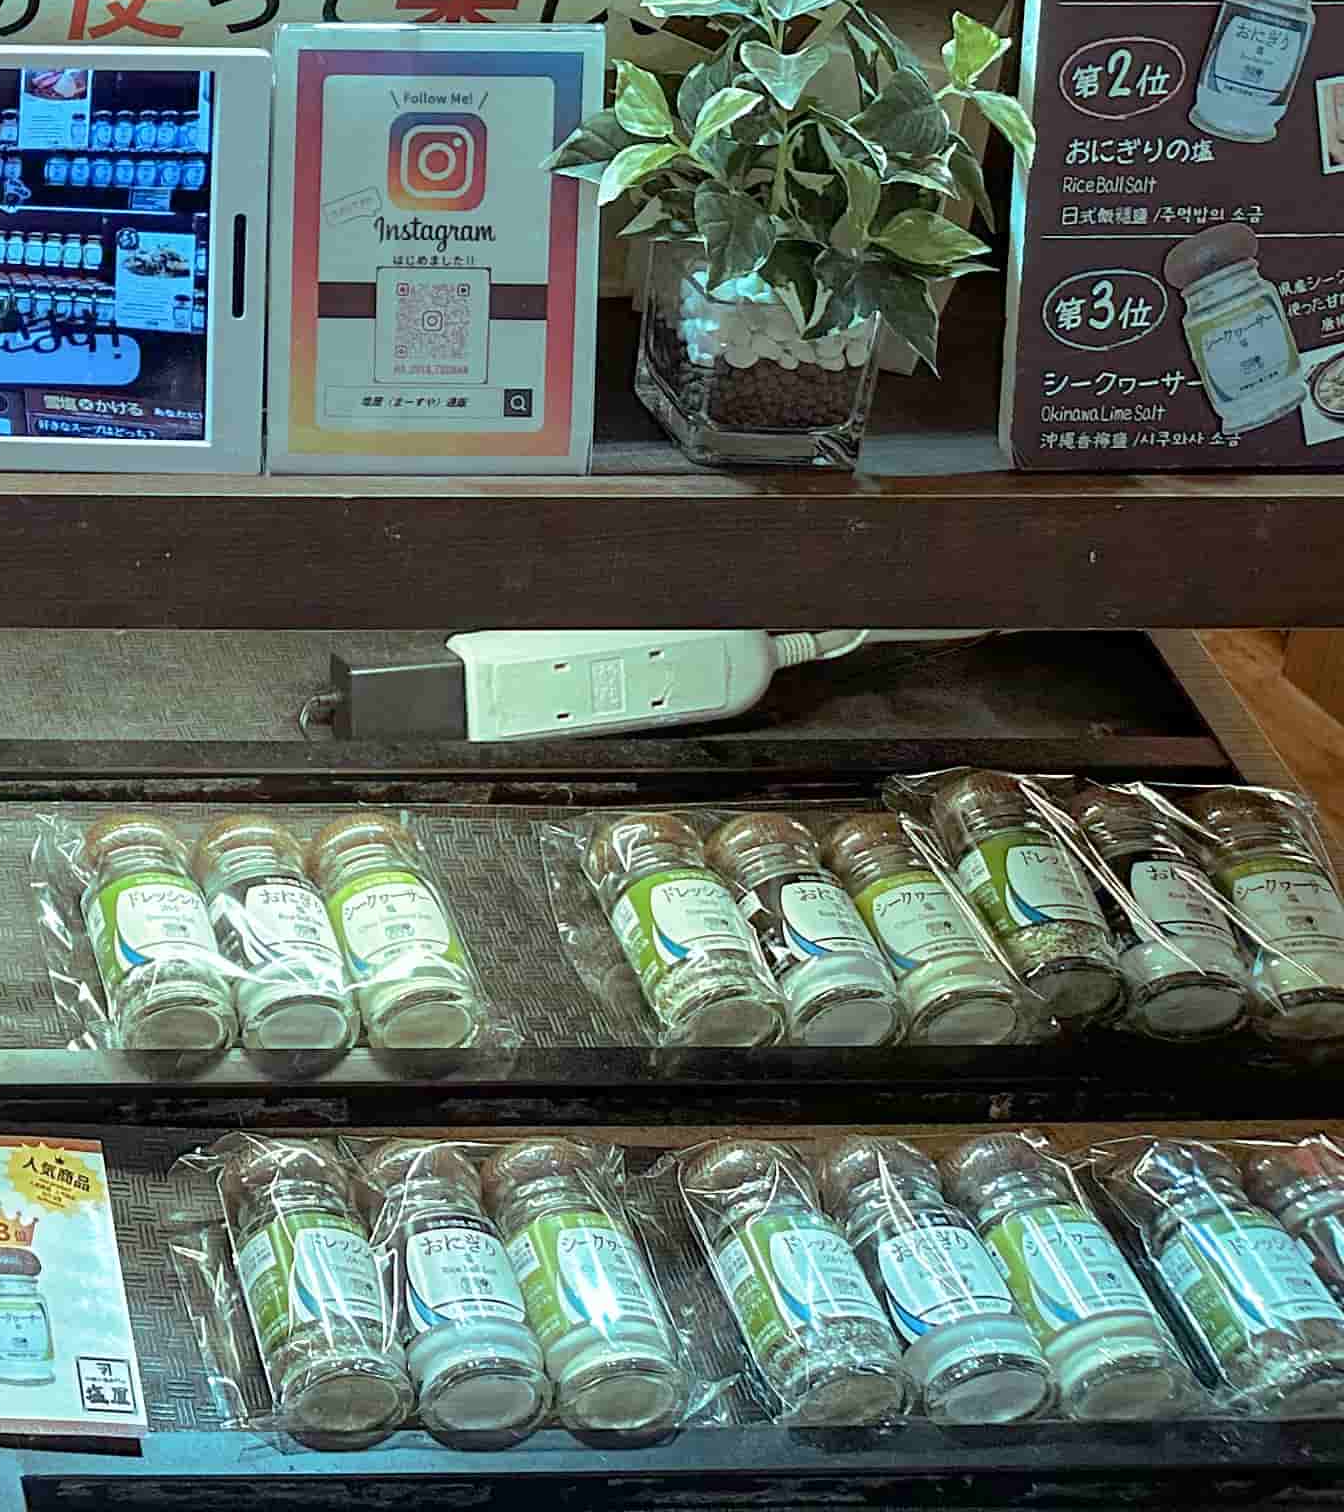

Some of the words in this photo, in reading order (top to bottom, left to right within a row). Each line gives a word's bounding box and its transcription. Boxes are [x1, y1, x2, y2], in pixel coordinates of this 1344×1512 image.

[1072, 49, 1170, 98] 第2位
[403, 93, 445, 105] Follow
[450, 93, 473, 105] Me!
[1065, 138, 1214, 164] おにぎりの塩
[373, 216, 496, 253] Instagram
[1055, 280, 1152, 329] 第3位
[22, 1157, 90, 1192] 人気商品
